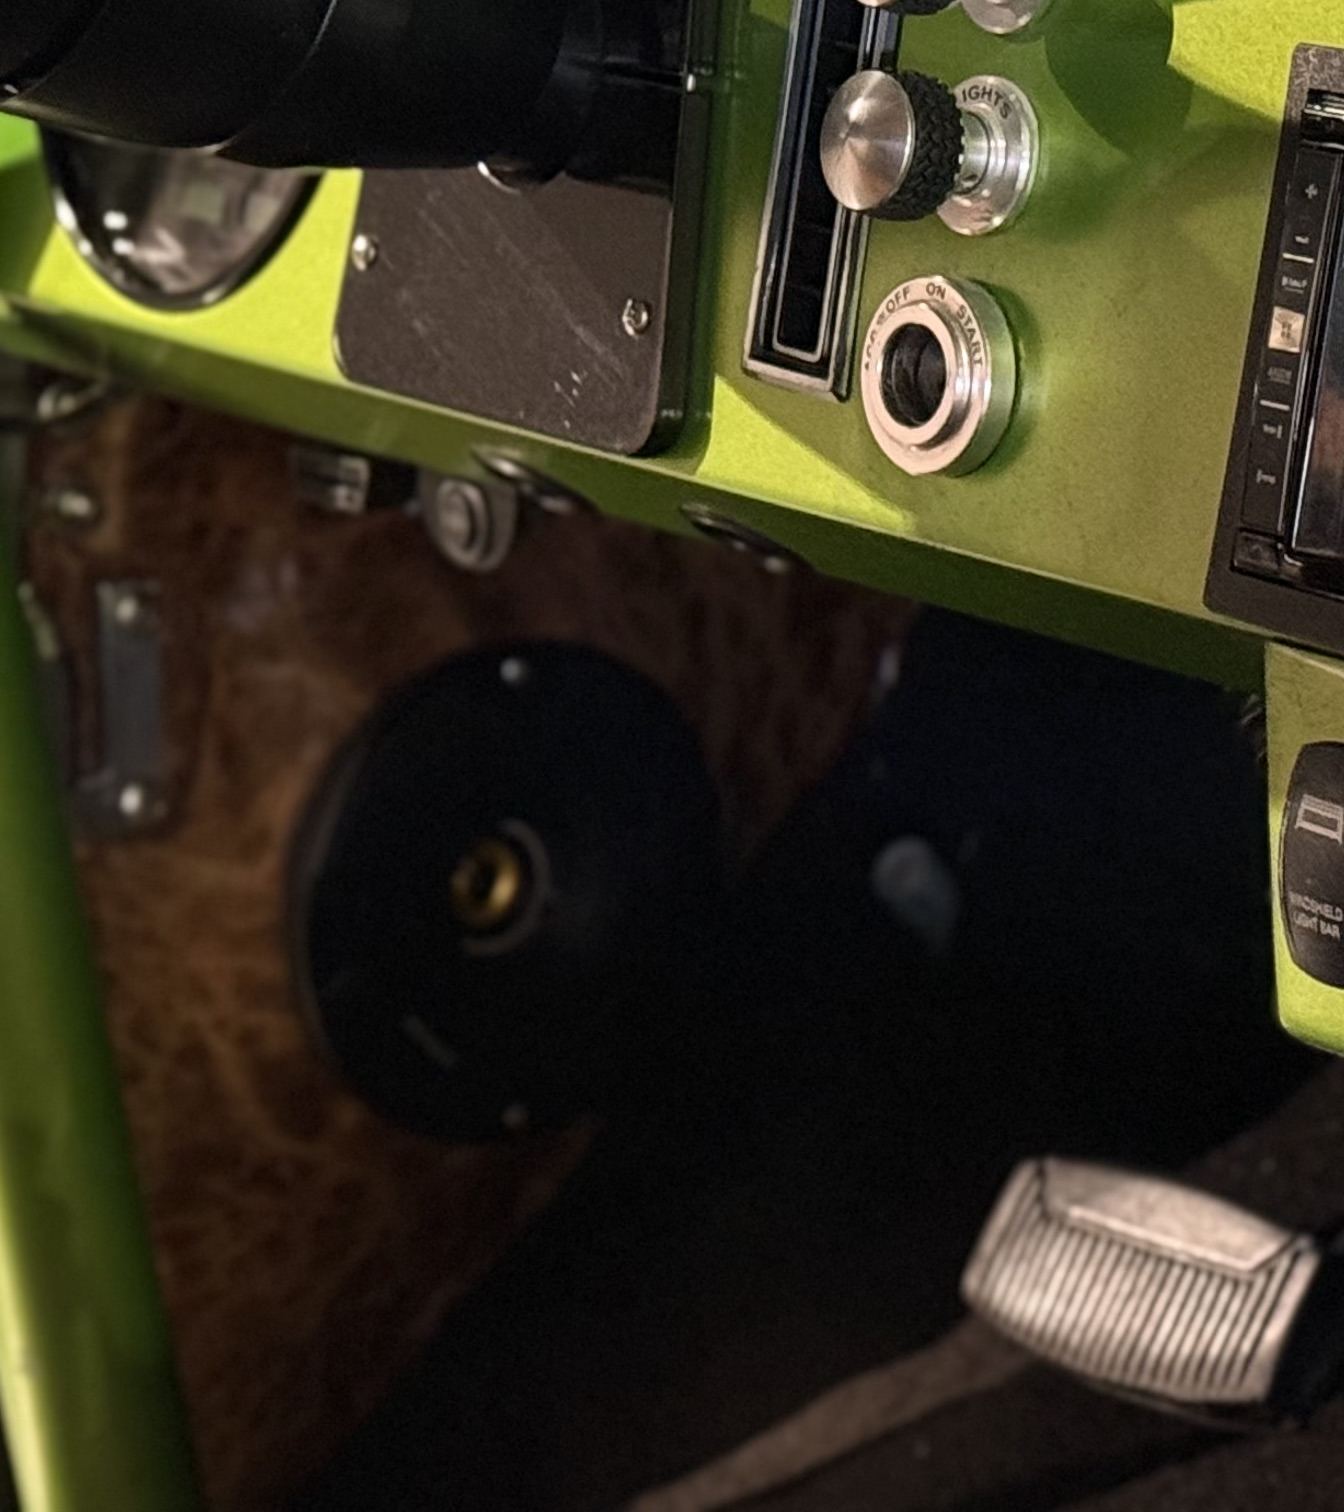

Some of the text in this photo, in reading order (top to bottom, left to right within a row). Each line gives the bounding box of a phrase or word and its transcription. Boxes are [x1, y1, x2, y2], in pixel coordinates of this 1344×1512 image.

[961, 85, 1011, 119] IGHTS
[885, 286, 910, 314] OFF
[925, 282, 946, 300] ON
[956, 305, 984, 366] START
[1319, 919, 1341, 941] BAR
